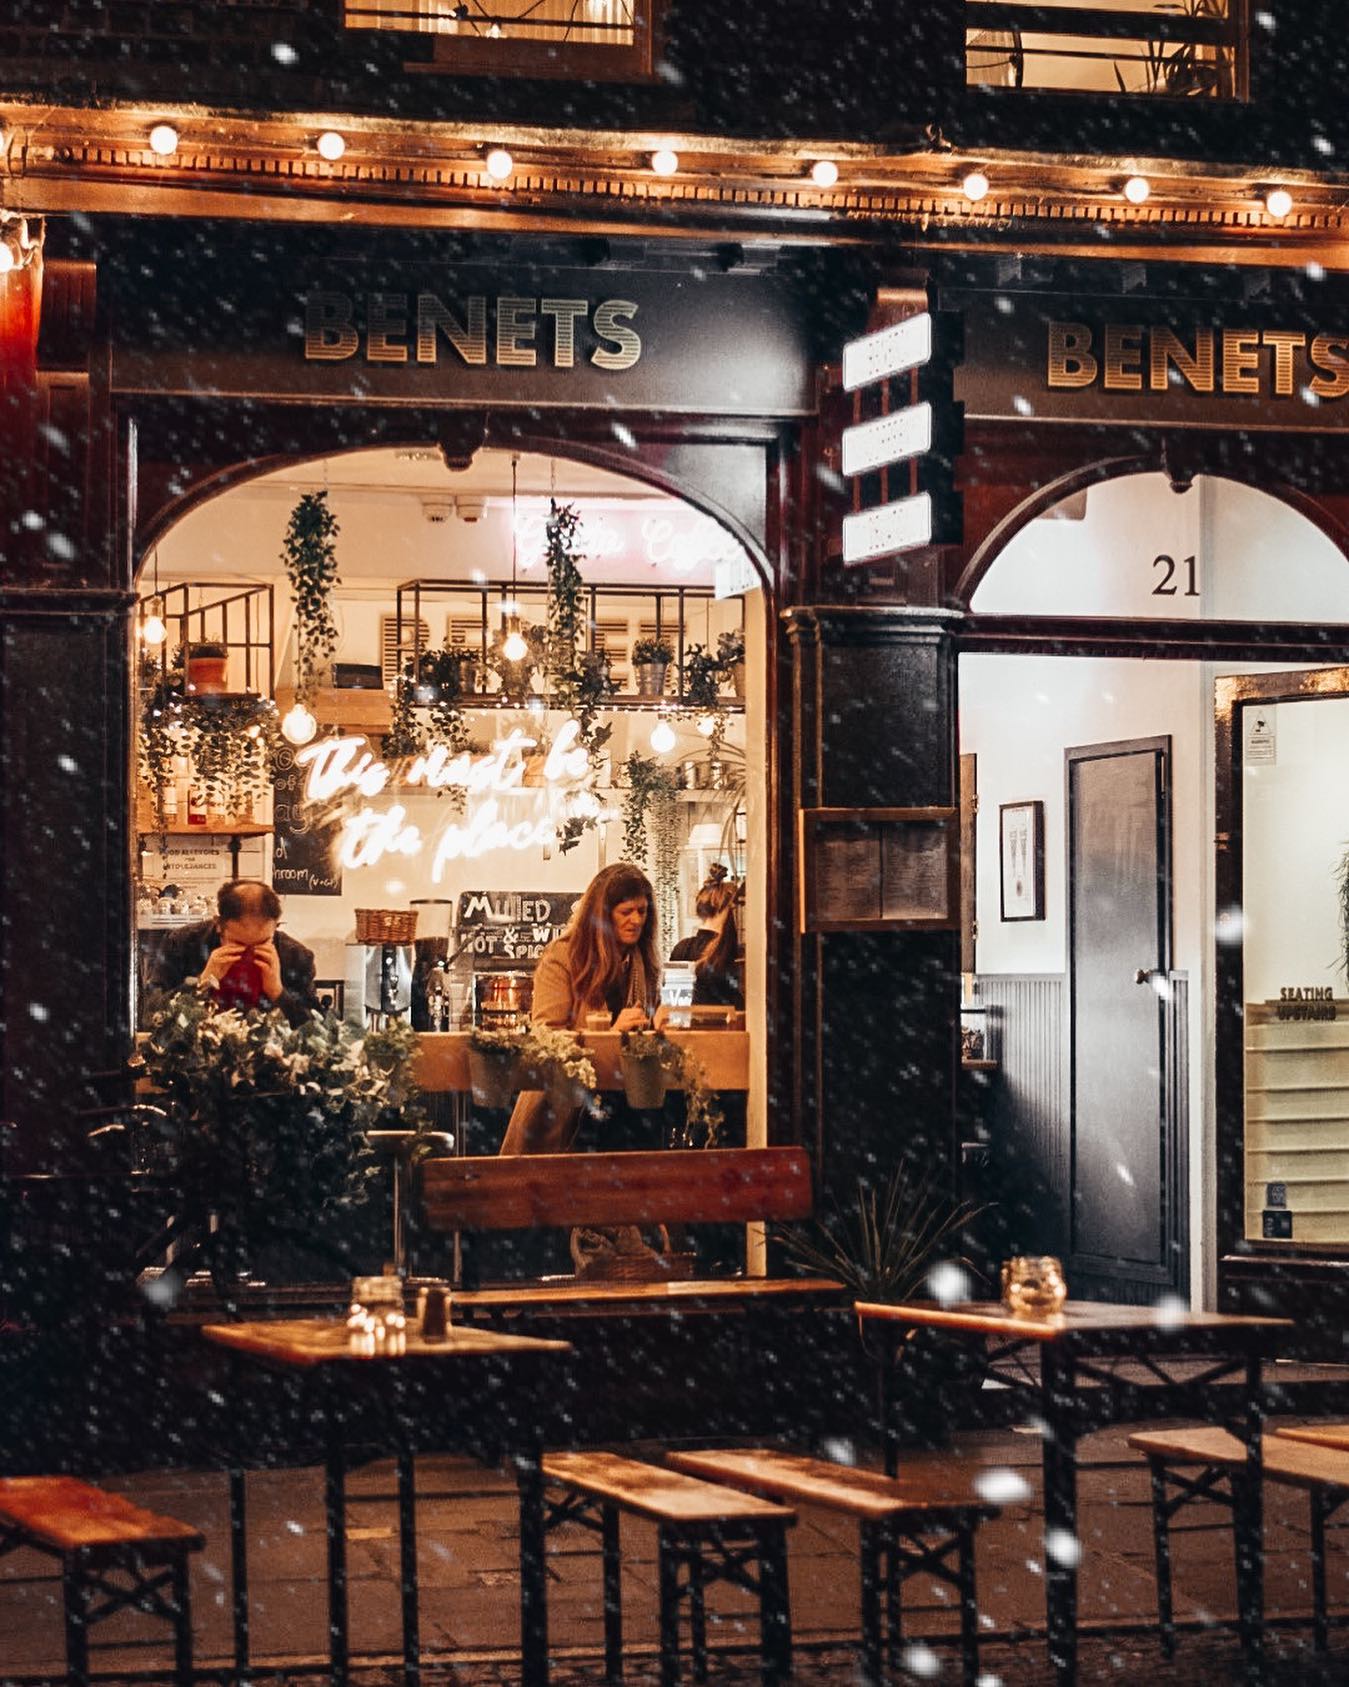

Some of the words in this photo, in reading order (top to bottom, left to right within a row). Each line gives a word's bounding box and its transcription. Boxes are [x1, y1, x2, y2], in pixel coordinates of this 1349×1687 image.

[304, 290, 642, 370] BENETS
[1048, 320, 1349, 398] BENETS
[1151, 554, 1200, 596] 21
[1280, 986, 1334, 1002] SEATING
